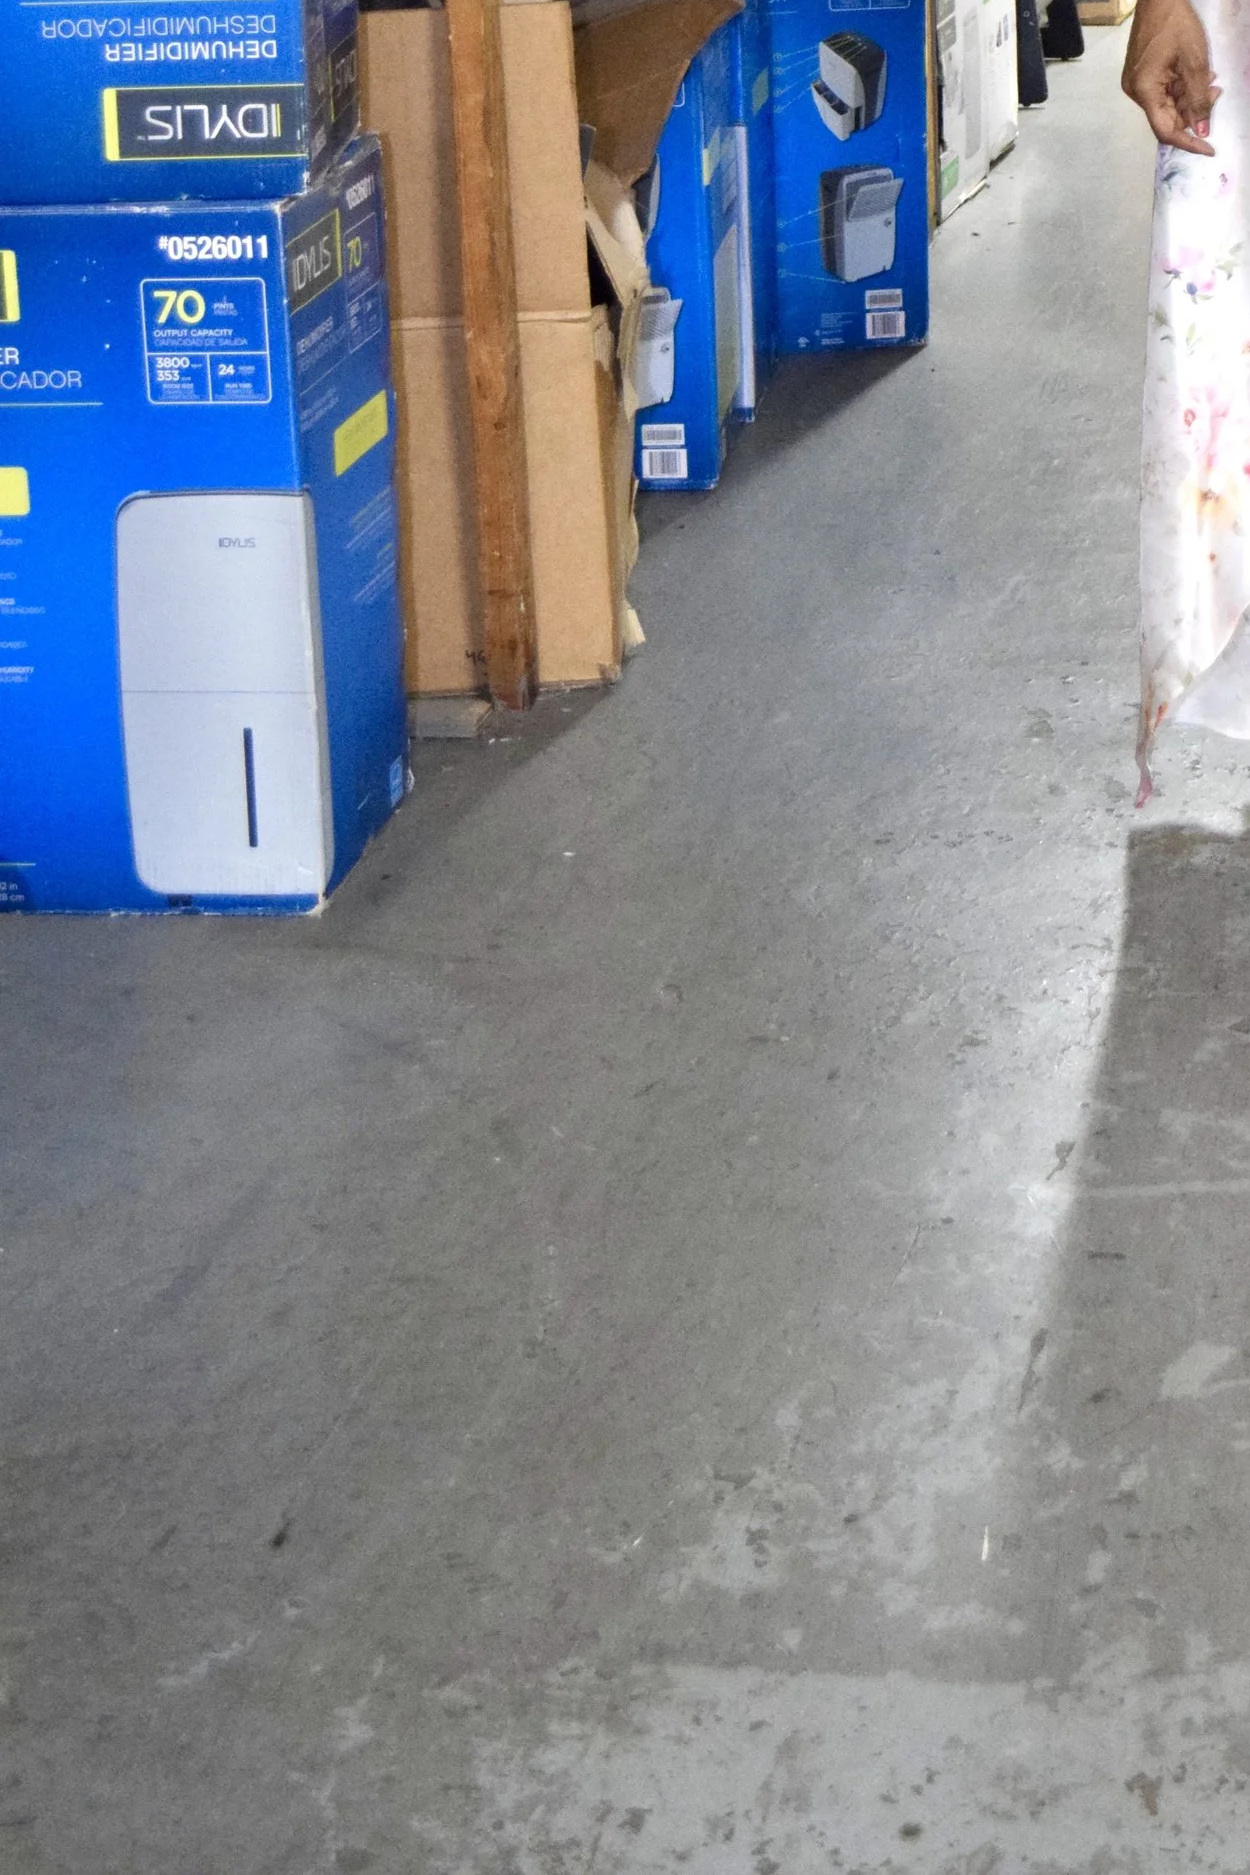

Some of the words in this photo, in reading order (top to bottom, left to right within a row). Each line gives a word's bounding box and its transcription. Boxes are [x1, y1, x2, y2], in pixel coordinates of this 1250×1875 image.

[41, 14, 276, 39] DESHUMIDIFICADOR
[104, 39, 277, 62] DEHUMIDIFIER
[145, 103, 281, 141] IDYLIS
[158, 234, 269, 260] #0526011
[347, 236, 362, 273] 70
[153, 289, 206, 324] 70
[153, 329, 188, 337] OUTPUT
[190, 328, 234, 337] CAPACITY
[155, 357, 190, 368] 3800
[218, 364, 235, 376] 24
[156, 369, 180, 381] 353
[217, 536, 257, 550] IDYLIS
